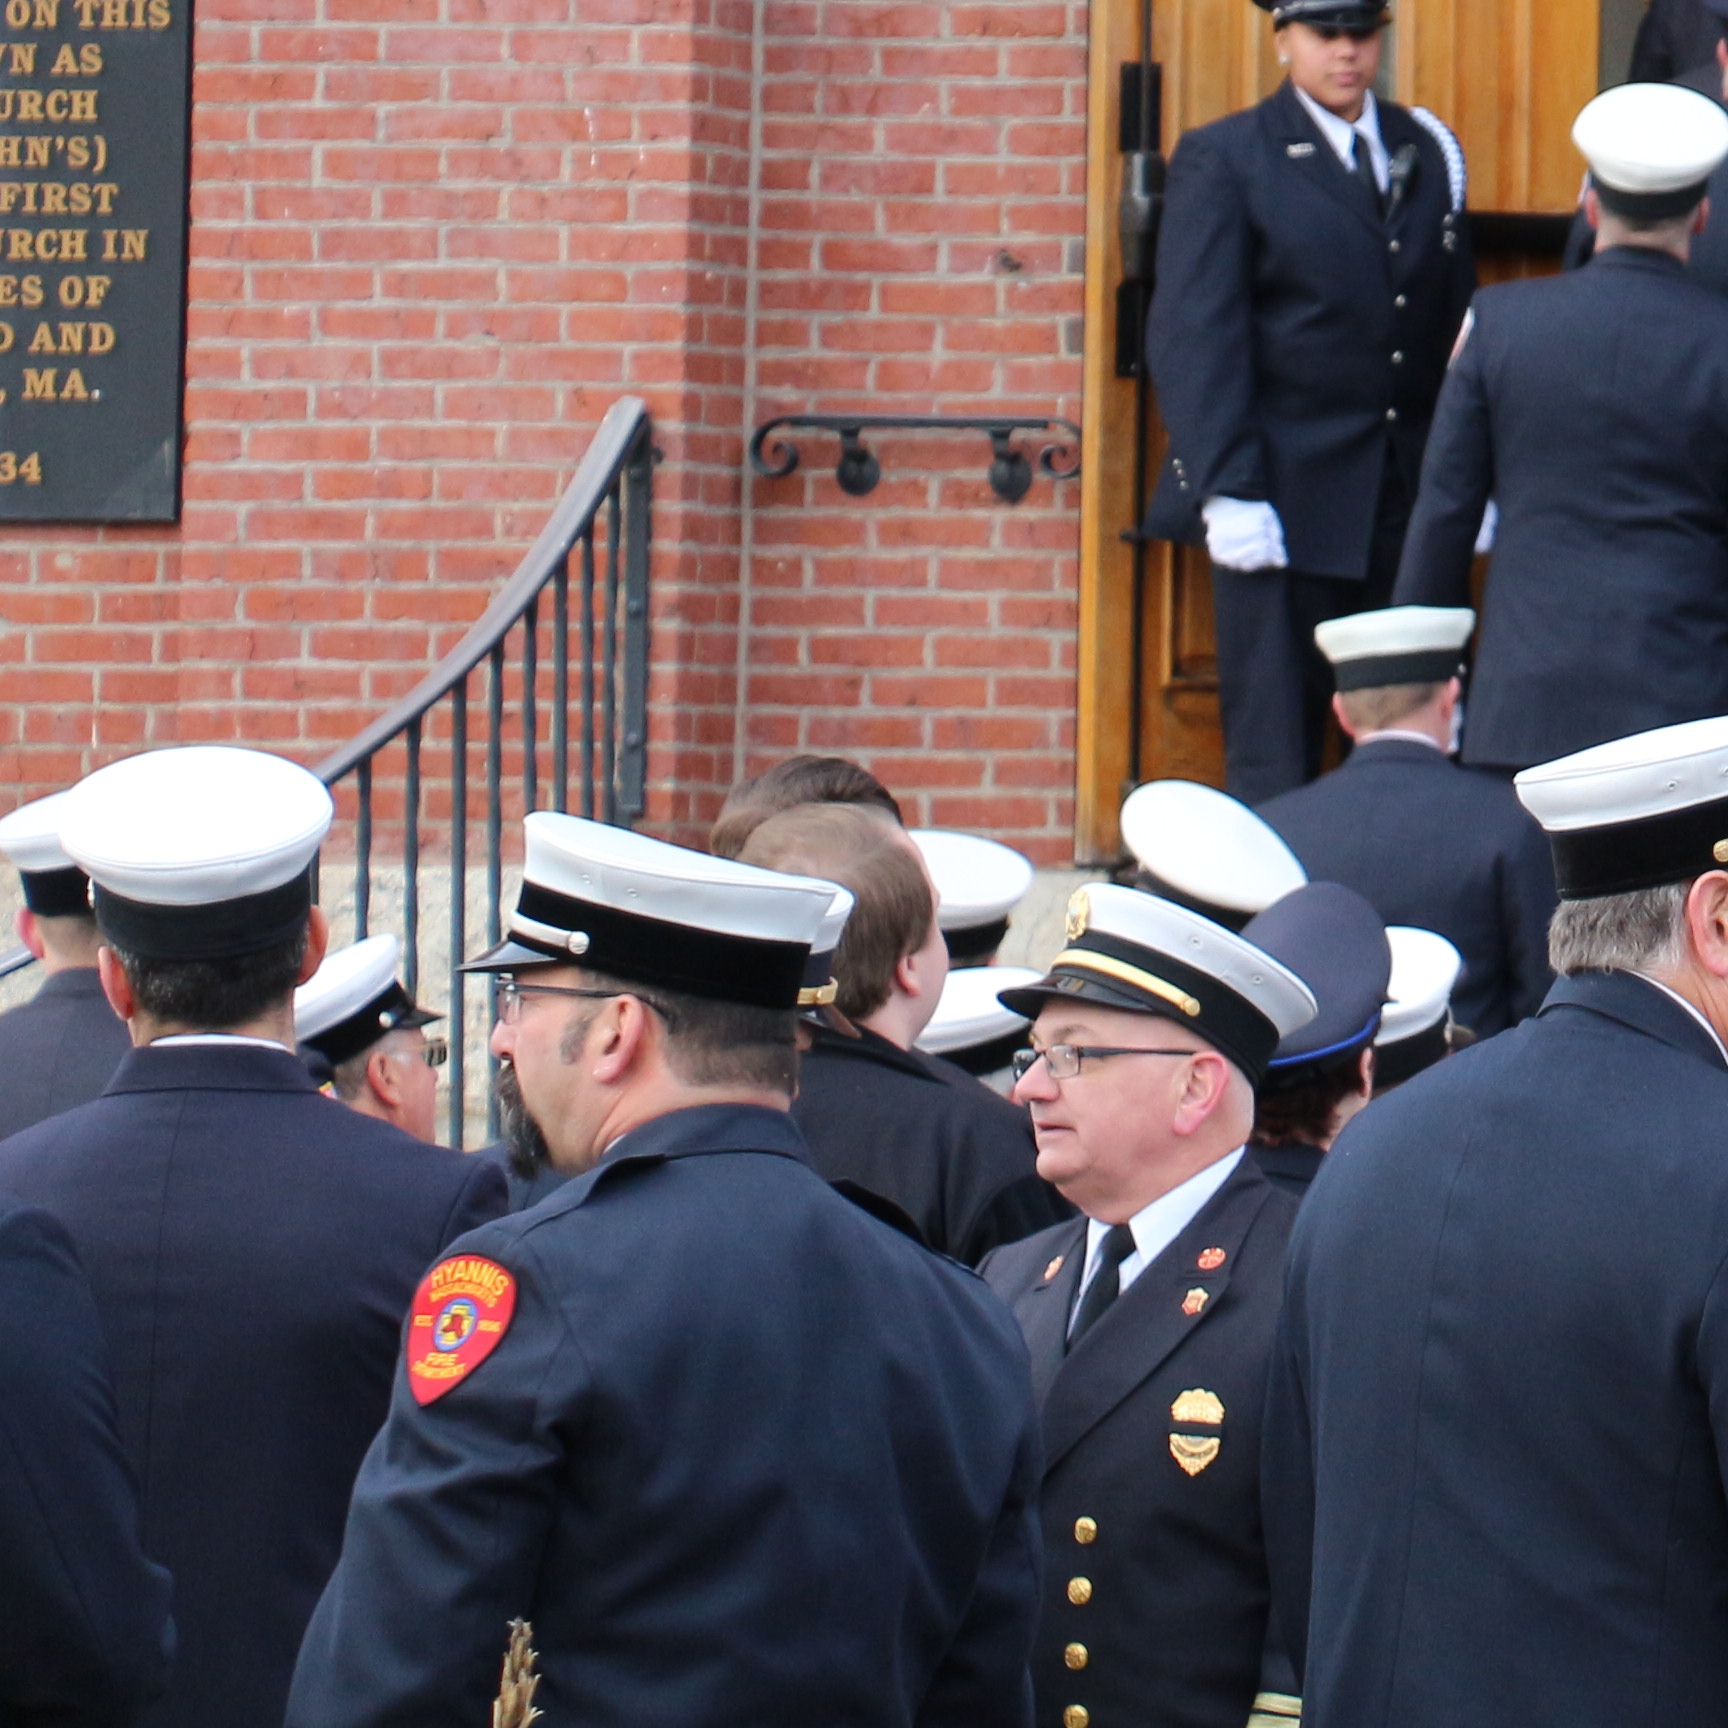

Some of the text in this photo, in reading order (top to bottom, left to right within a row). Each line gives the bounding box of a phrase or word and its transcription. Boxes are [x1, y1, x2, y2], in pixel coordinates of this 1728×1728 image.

[50, 43, 103, 76] AS
[0, 182, 119, 215] FIRST
[101, 228, 149, 261] IN
[58, 274, 112, 308] OF
[27, 321, 115, 355] AND
[430, 1260, 510, 1296] HYANNIS
